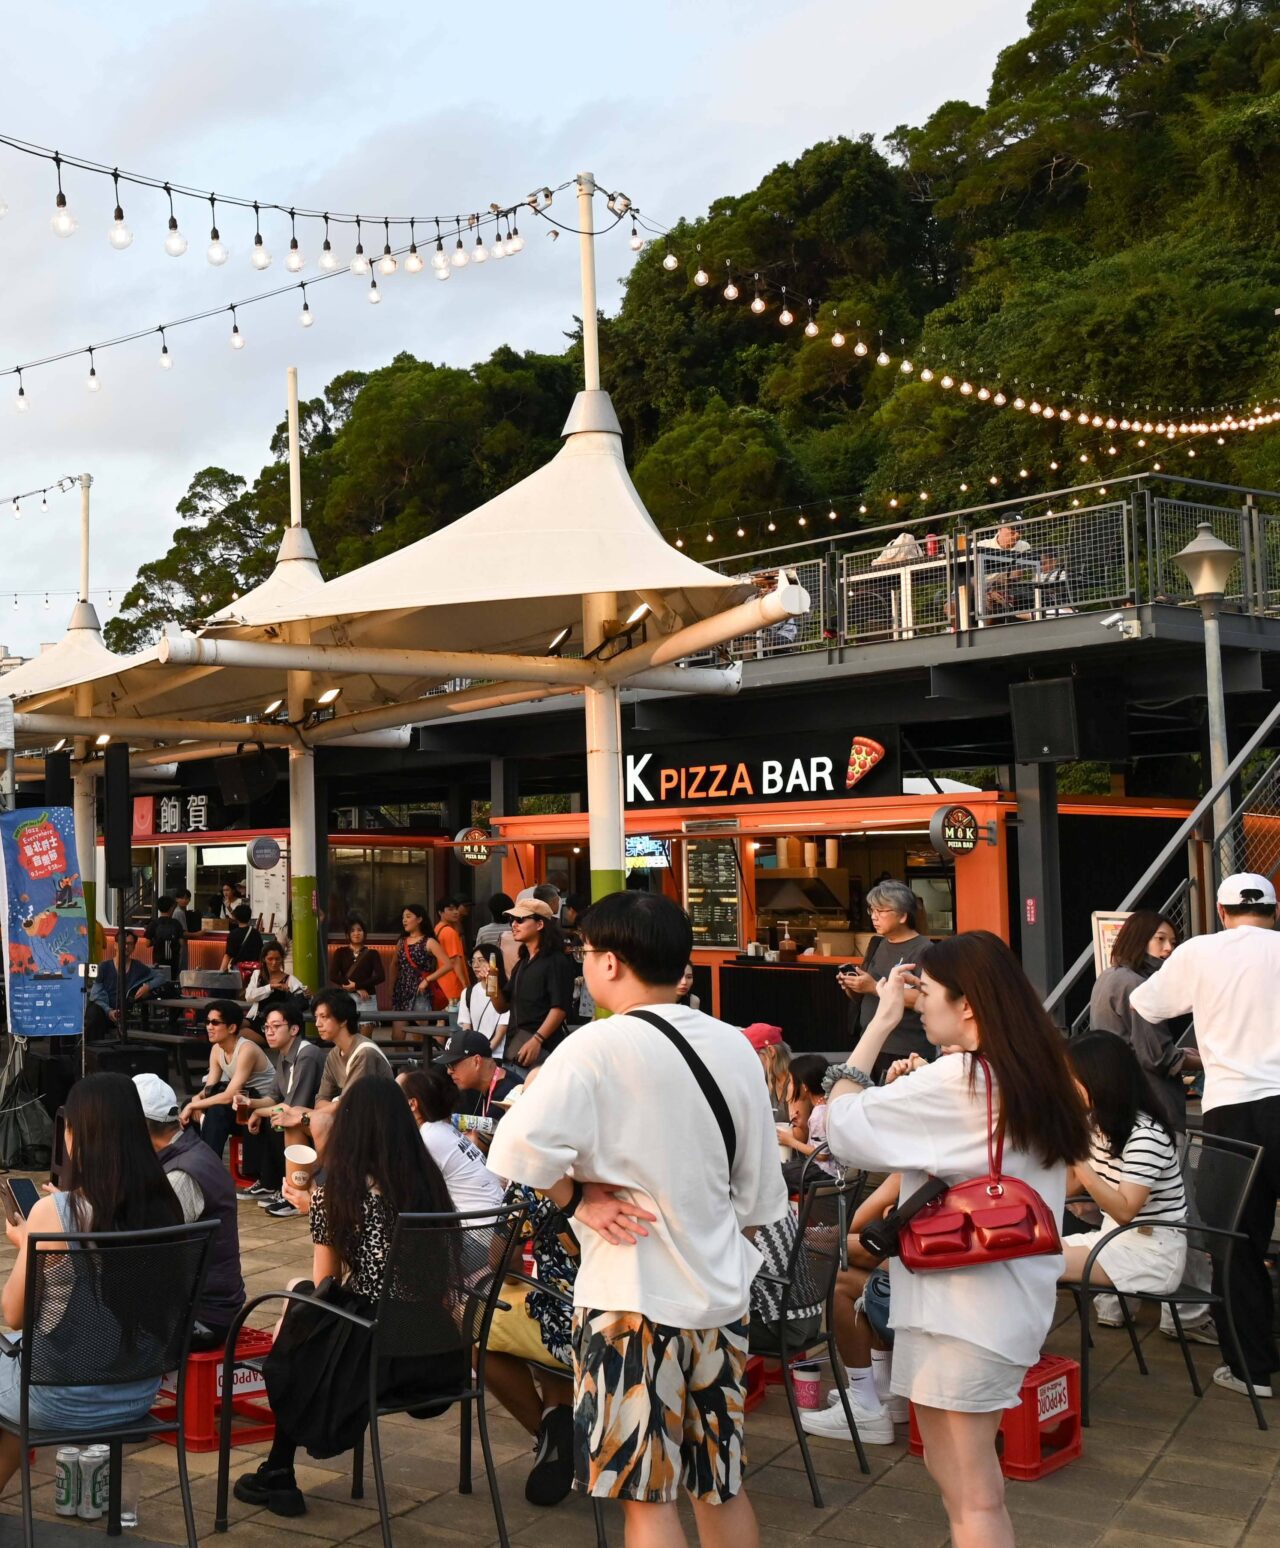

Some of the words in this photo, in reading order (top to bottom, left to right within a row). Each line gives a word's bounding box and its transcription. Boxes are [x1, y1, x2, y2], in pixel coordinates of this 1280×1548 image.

[660, 762, 753, 801] PIZZA
[762, 756, 835, 795] BAR
[218, 1370, 265, 1387] SAPPOO
